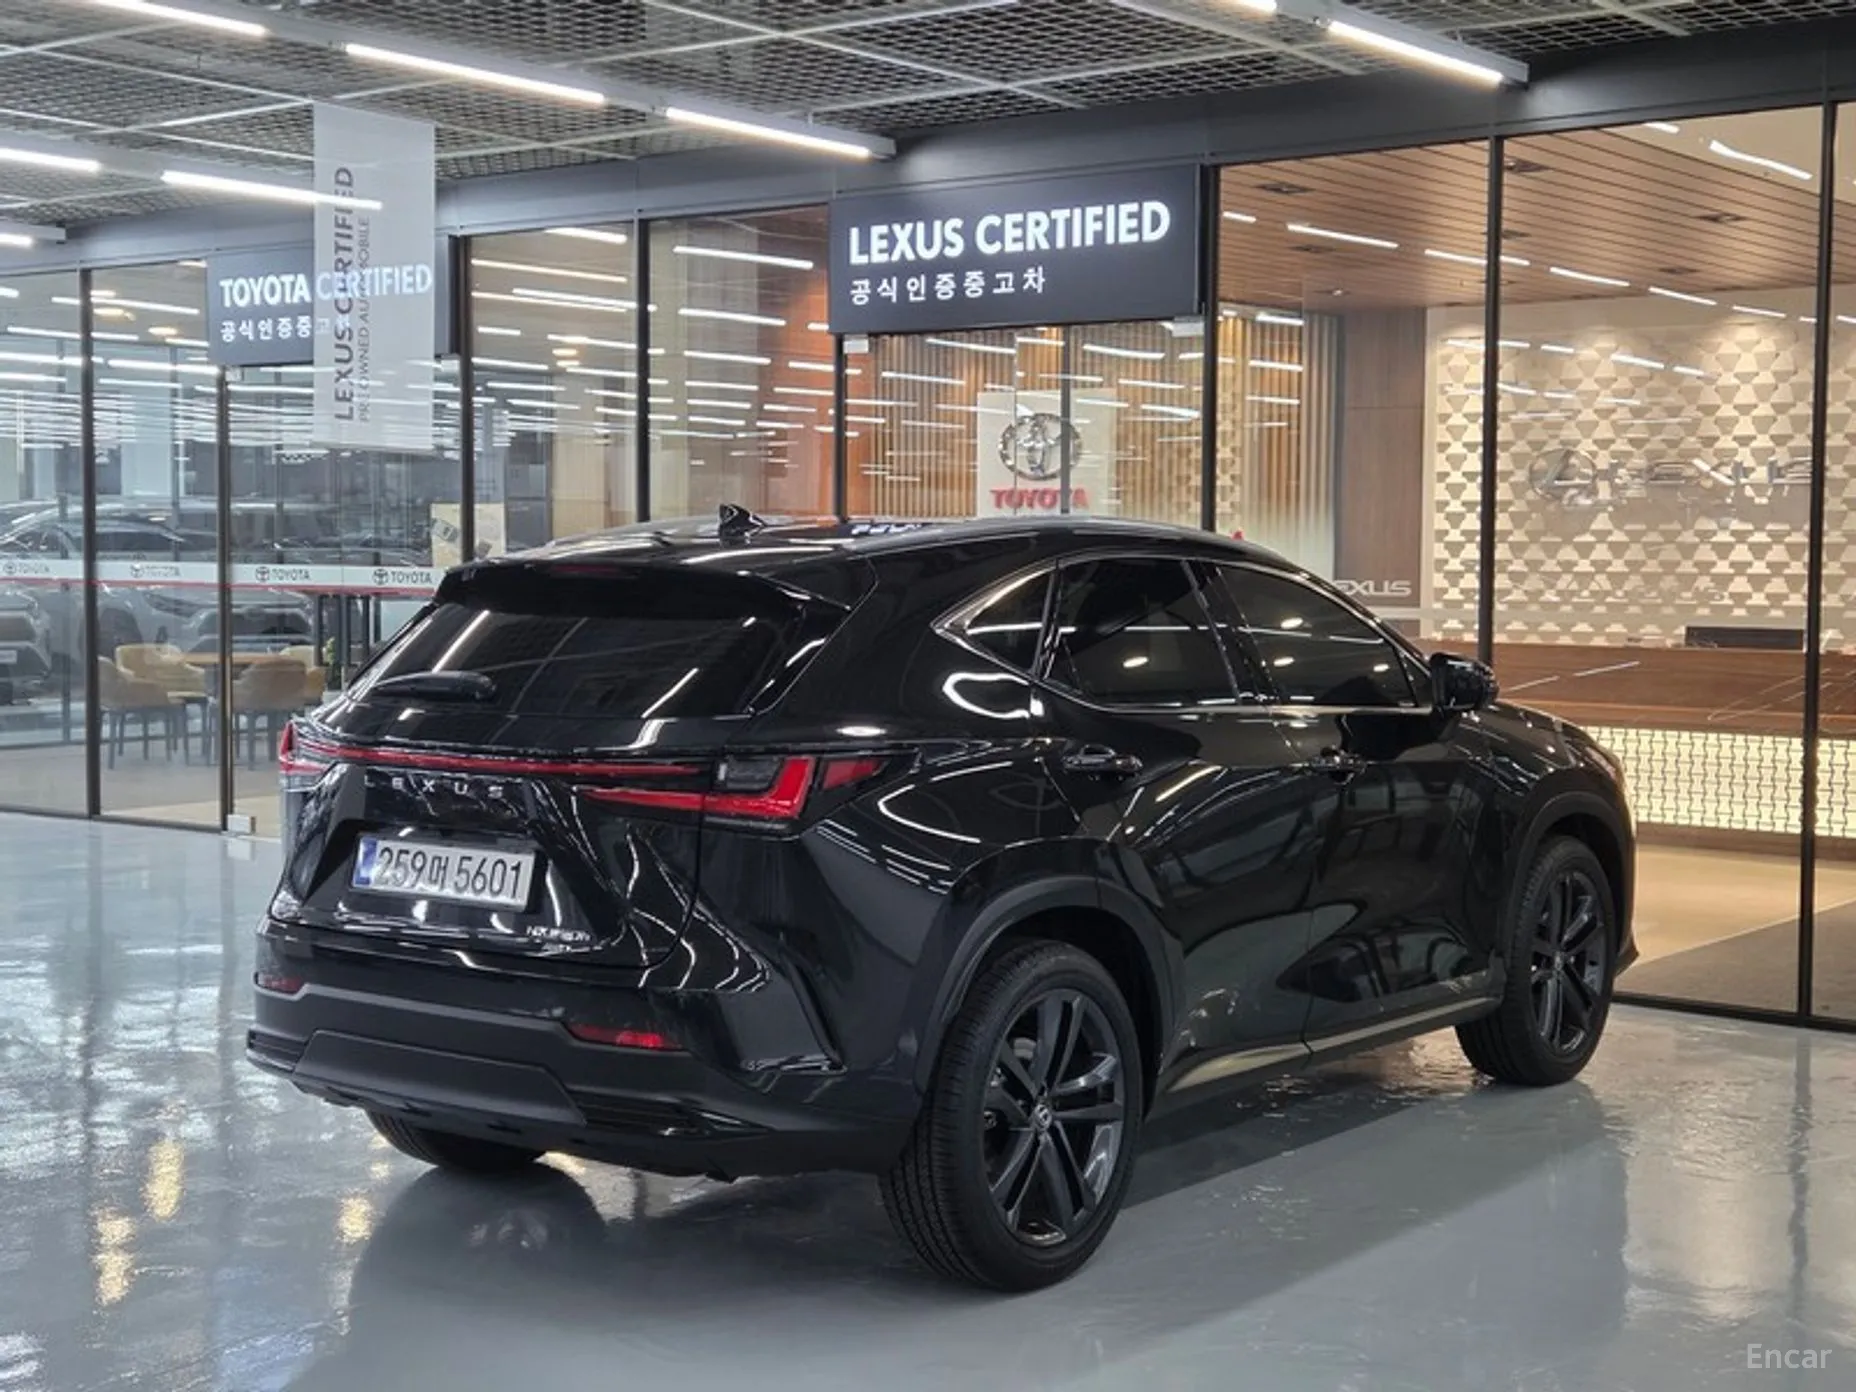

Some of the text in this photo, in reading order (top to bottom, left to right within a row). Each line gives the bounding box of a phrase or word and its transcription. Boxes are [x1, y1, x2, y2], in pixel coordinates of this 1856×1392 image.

[850, 201, 1171, 265] LEXUS CERTIFIED
[219, 264, 433, 308] TOYOTA CERTIFIED
[358, 218, 370, 323] AUMOBILE
[850, 266, 1046, 306] 공식인증중고차
[335, 323, 354, 421] LEXUS
[989, 487, 1090, 510] TOYOA
[272, 568, 311, 581] TOYOTA
[388, 570, 433, 584] TOYOTA
[1333, 579, 1412, 597] EXUS
[364, 774, 504, 799] LEXUS
[454, 856, 522, 899] 5601
